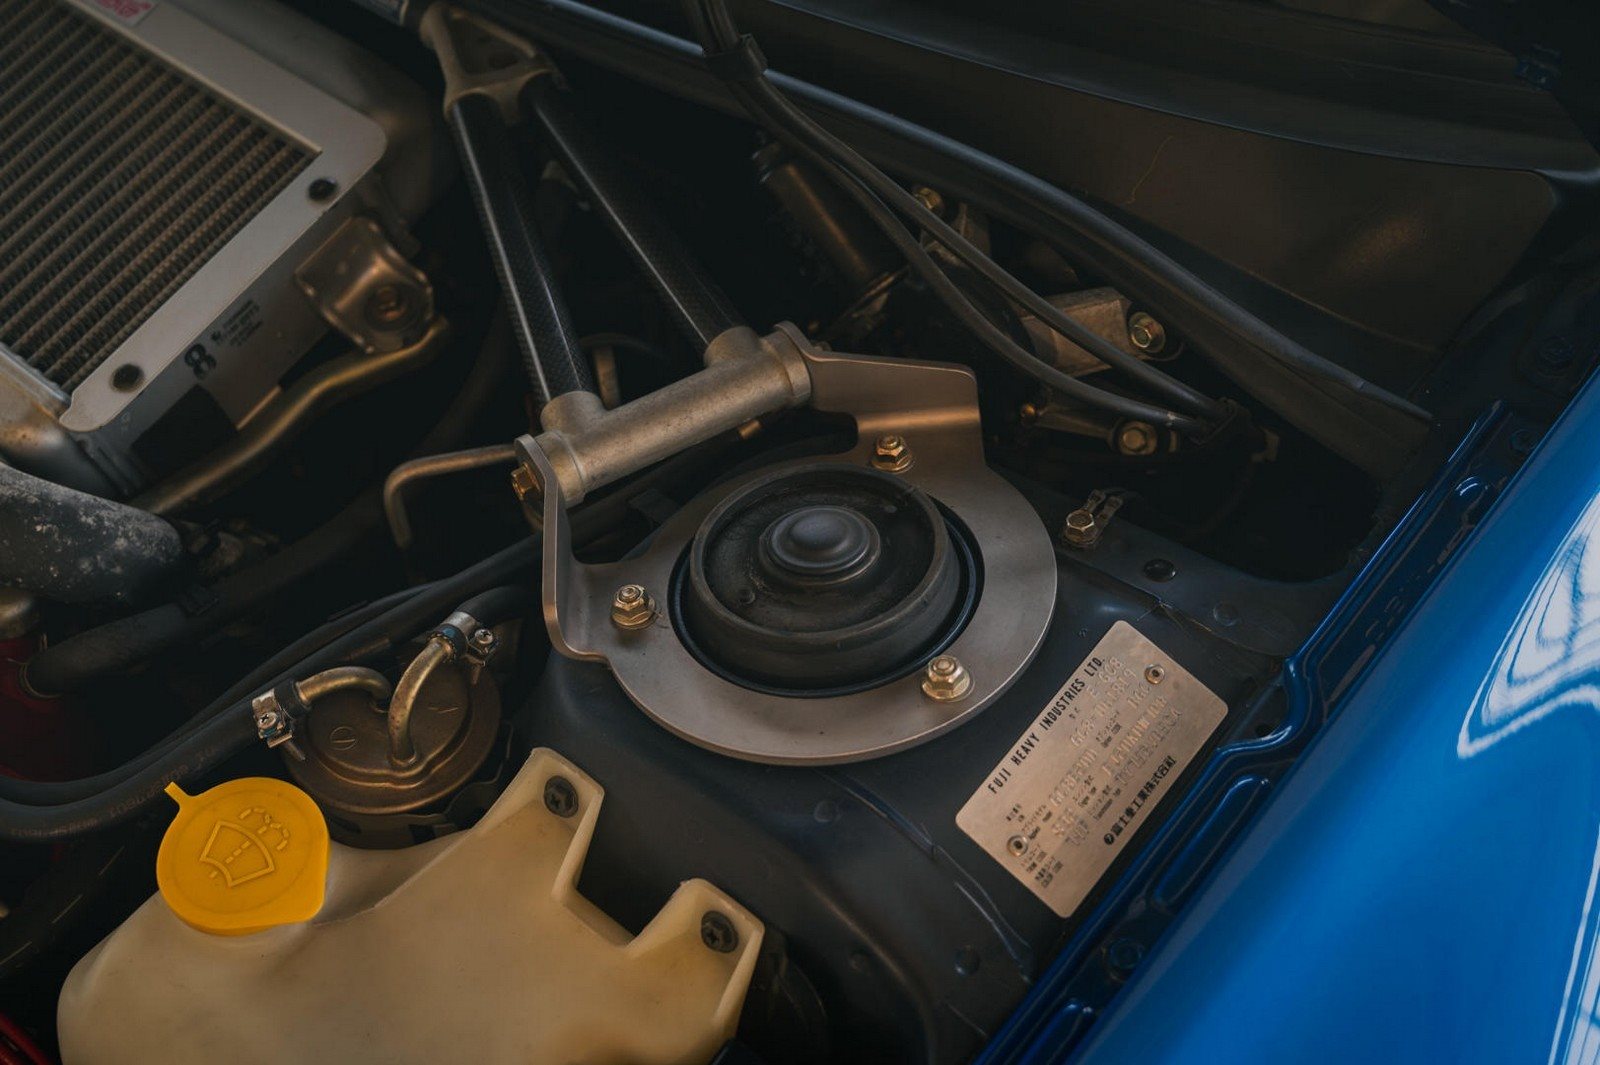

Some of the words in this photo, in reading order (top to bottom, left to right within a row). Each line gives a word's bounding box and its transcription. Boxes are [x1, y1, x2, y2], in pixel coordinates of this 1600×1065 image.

[987, 771, 1011, 794] FUJI
[1011, 733, 1040, 765] HEAVY
[1039, 679, 1085, 730] INDUSTRIES
